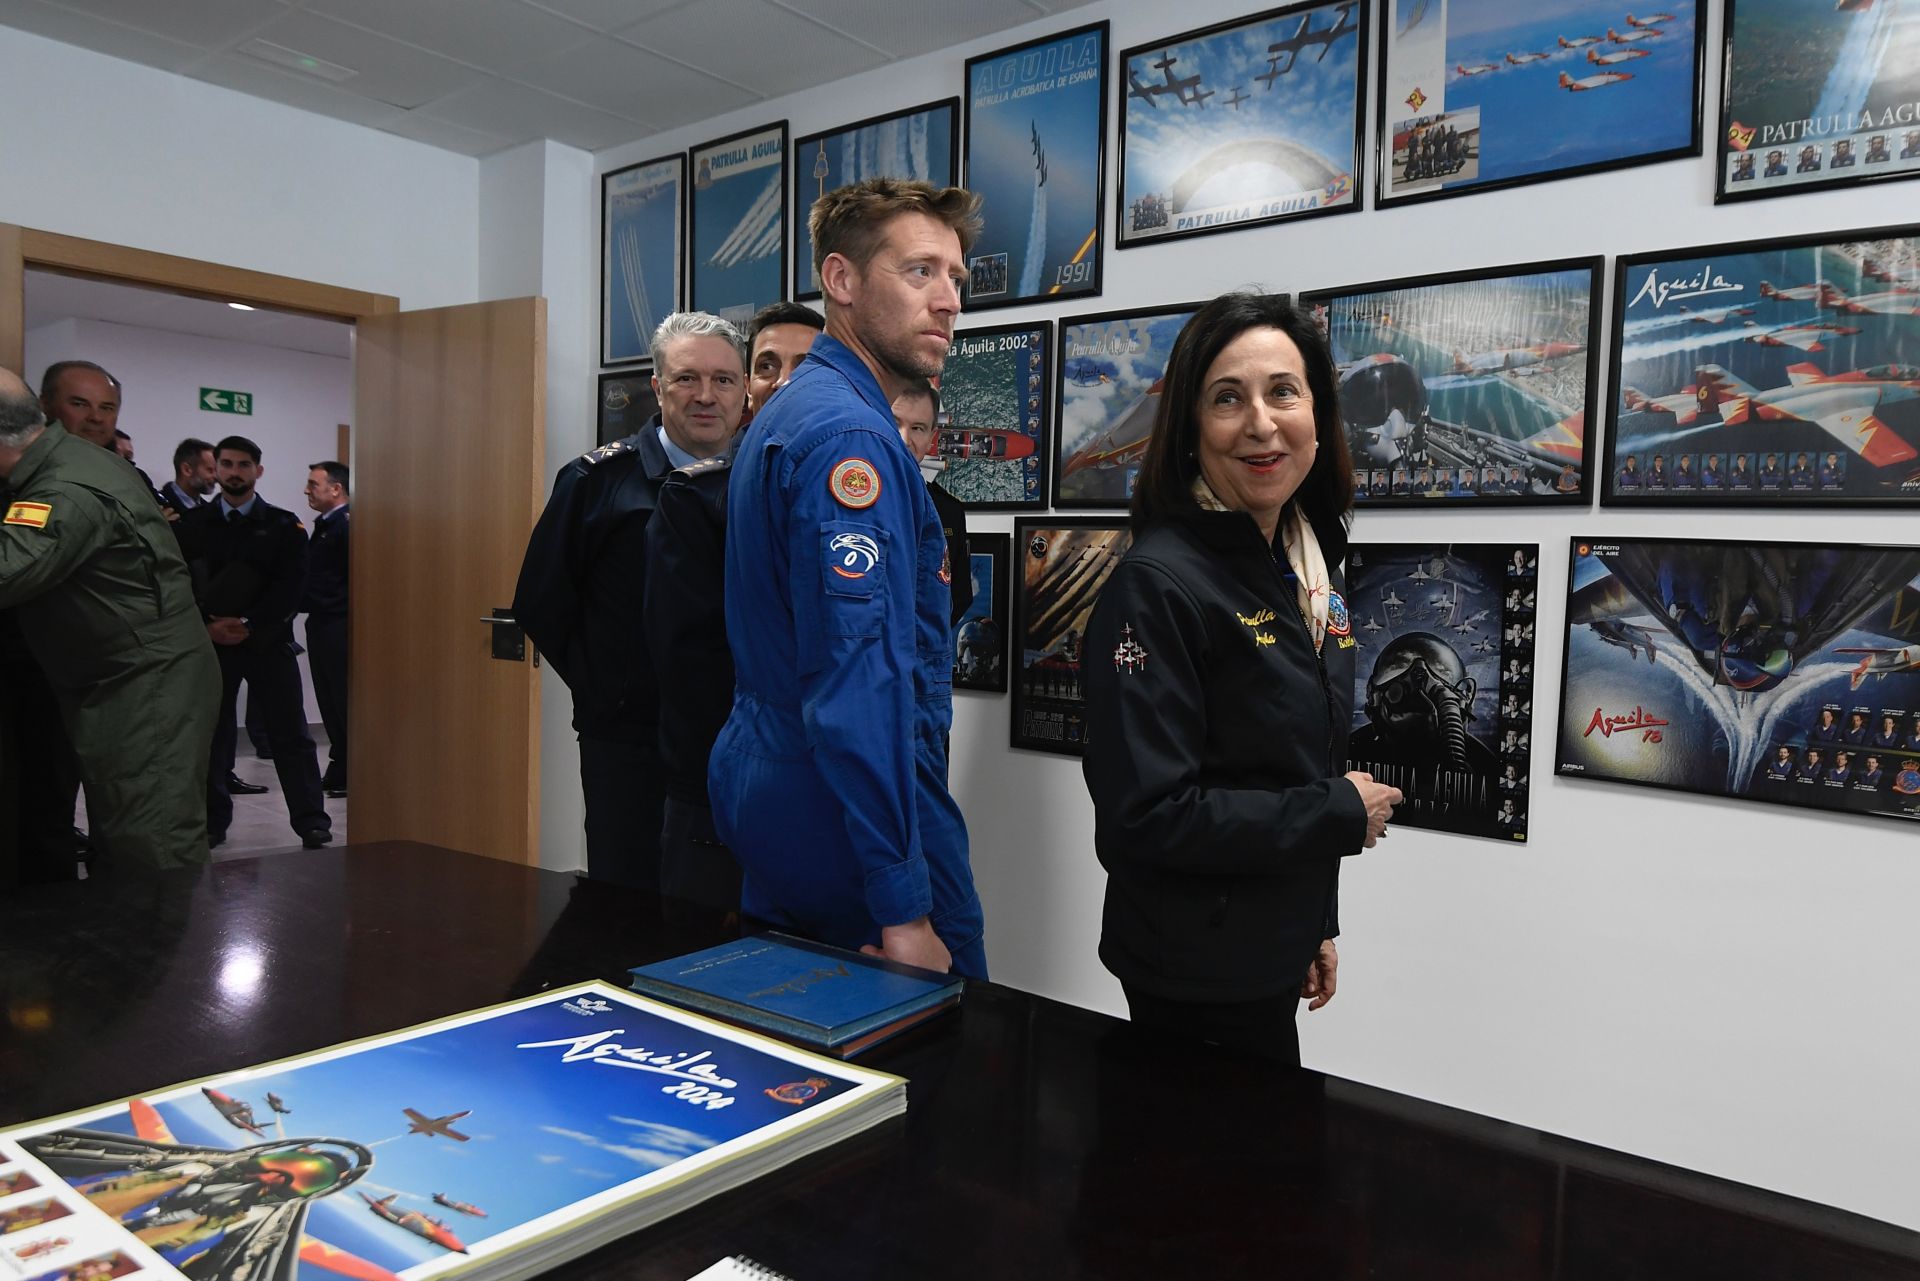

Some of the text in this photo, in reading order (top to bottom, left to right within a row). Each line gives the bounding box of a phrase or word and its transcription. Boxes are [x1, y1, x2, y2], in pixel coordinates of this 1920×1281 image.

[976, 36, 1097, 95] AGUILA
[975, 67, 1097, 109] PATRULLA ACROBATICA DE ESPAÑA
[1729, 128, 1752, 143] 94
[1762, 110, 1873, 143] PATRULLA
[711, 138, 782, 170] PATRULLA AGUILA
[1325, 179, 1346, 199] 92
[1176, 196, 1318, 230] PATRULLA AGUILA
[1056, 262, 1091, 285] 1991
[1629, 265, 1744, 308] Águila
[961, 338, 995, 357] Águila
[999, 335, 1028, 351] 2002
[1072, 335, 1106, 357] Patrulla
[1698, 386, 1708, 400] 6
[1434, 763, 1487, 810] ÁGUILA
[662, 1081, 736, 1111] 2024
